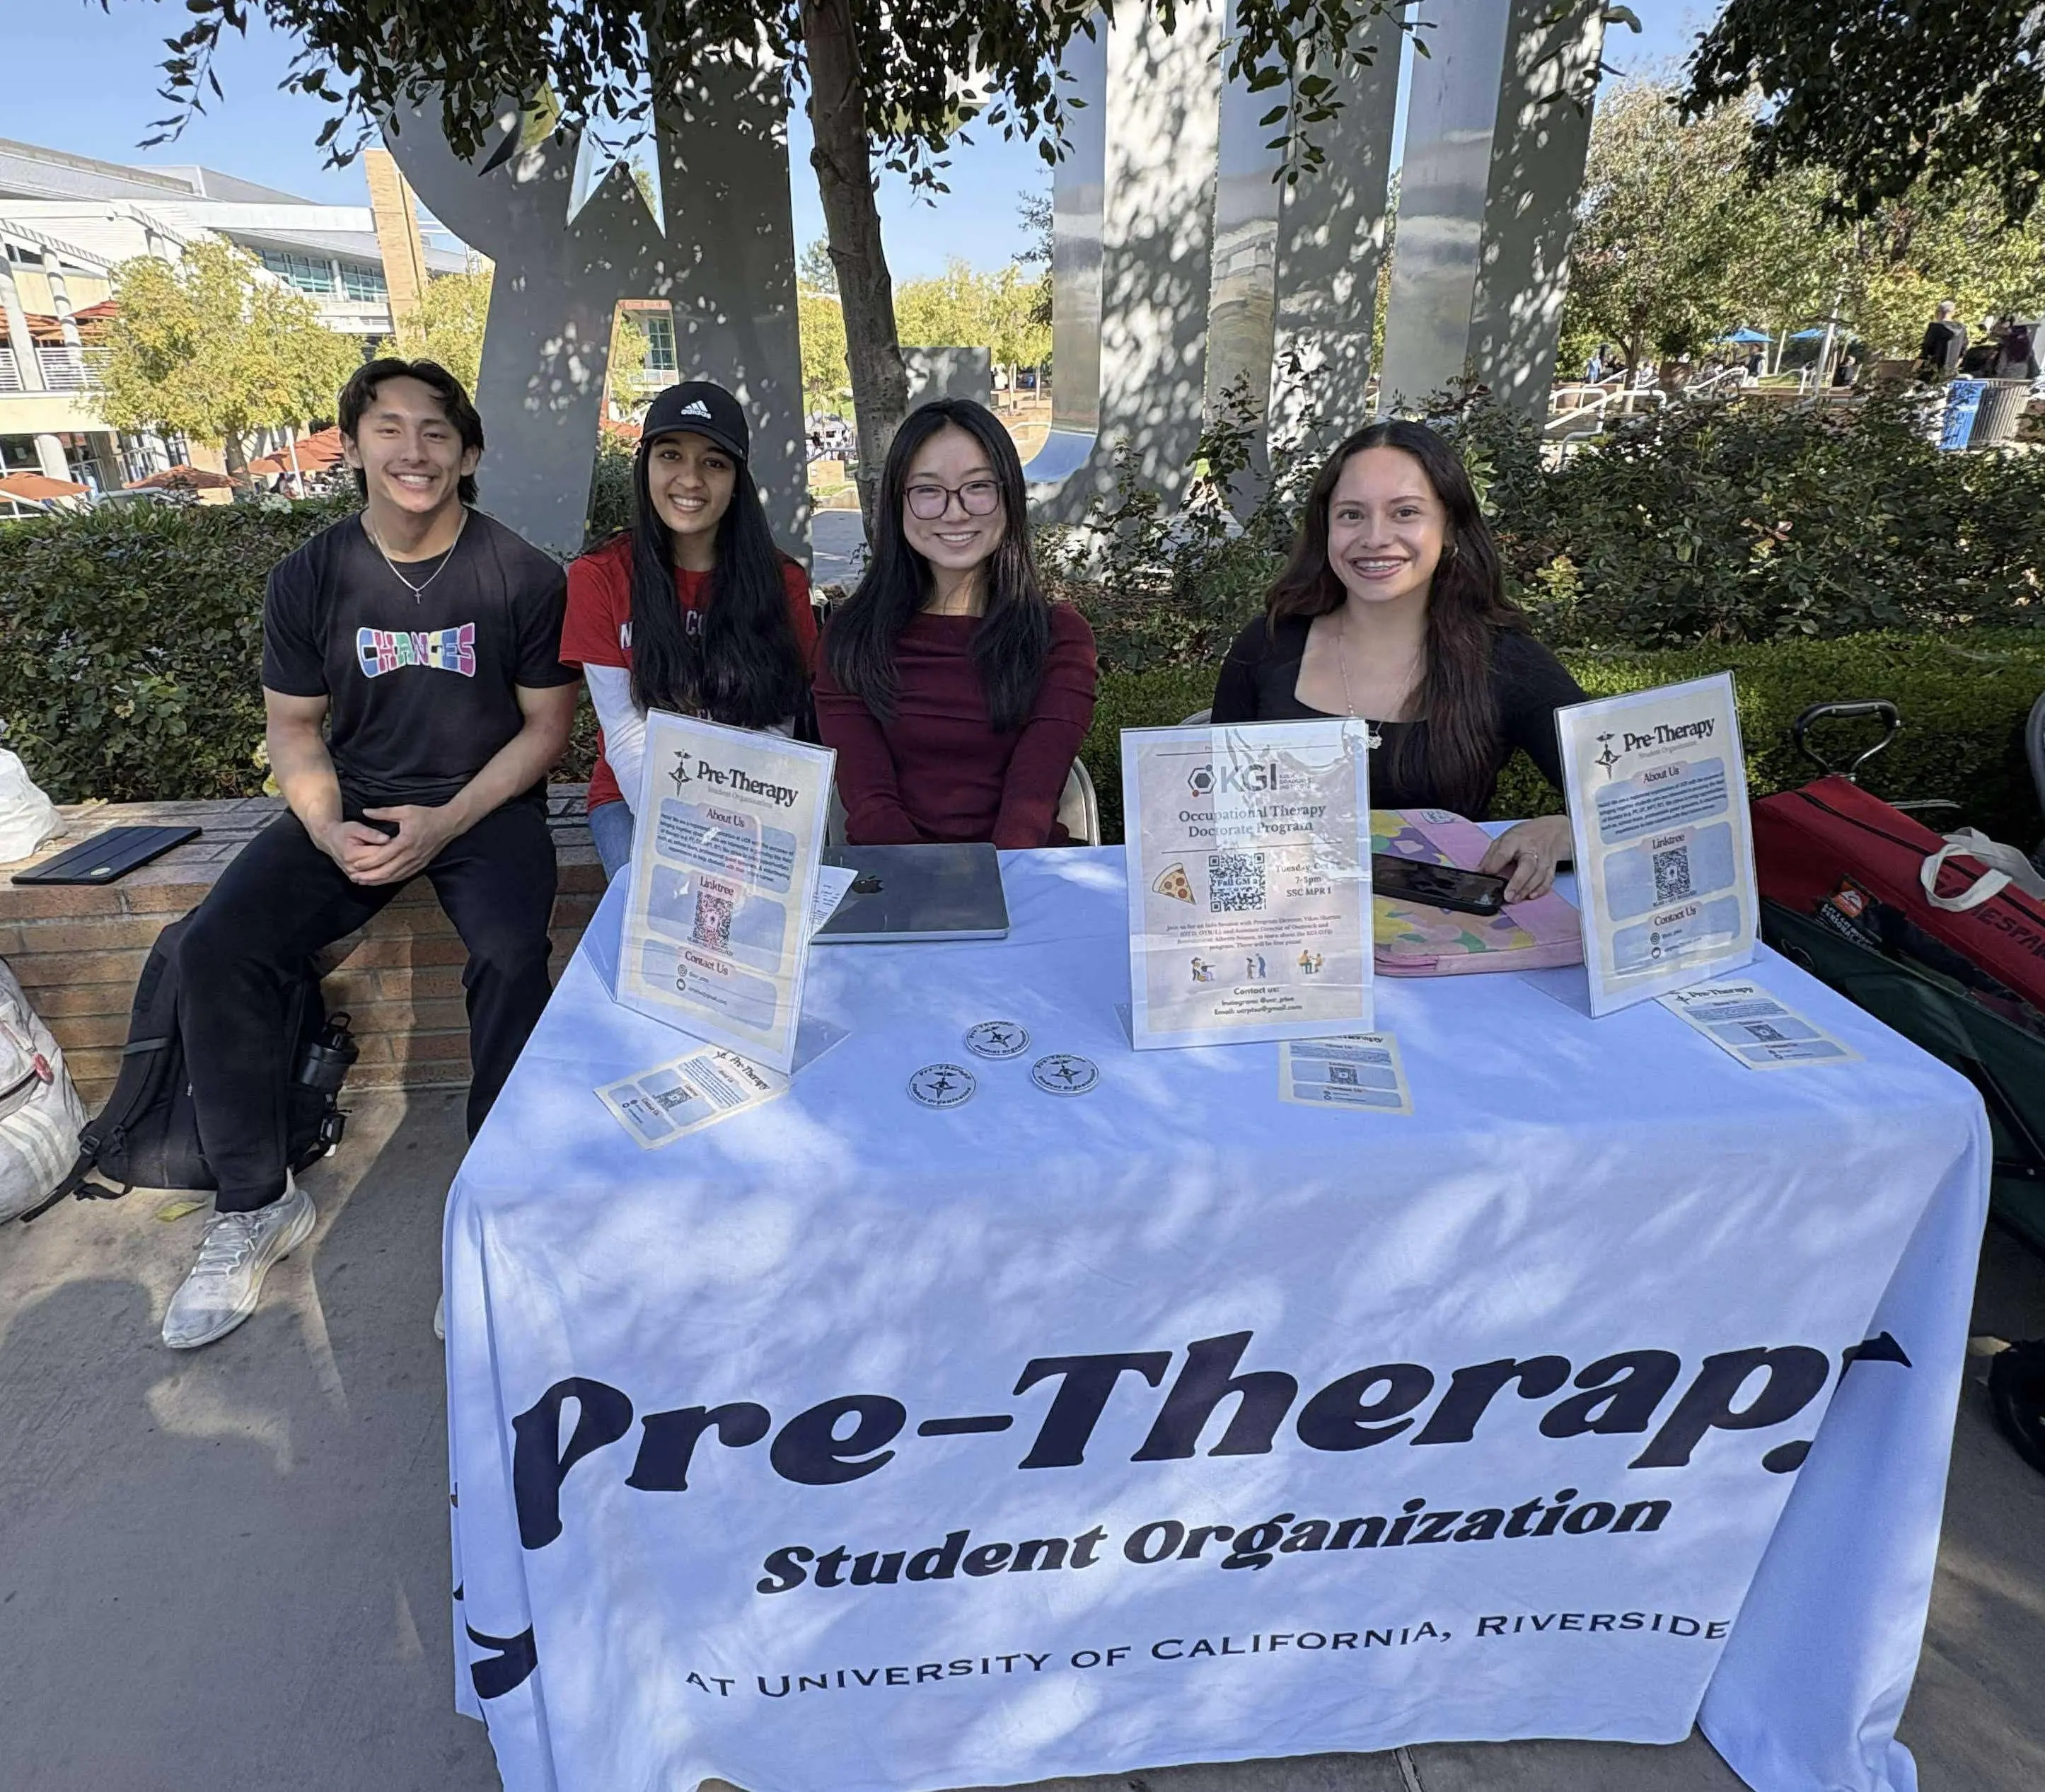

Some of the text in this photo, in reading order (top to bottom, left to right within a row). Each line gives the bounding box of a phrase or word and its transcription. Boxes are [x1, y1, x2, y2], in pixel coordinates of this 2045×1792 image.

[356, 622, 476, 678] CHANGES
[1623, 718, 1715, 751] Pre-Therapy
[697, 761, 799, 807] Pre-Therapy
[1221, 763, 1277, 793] KGI
[1643, 765, 1680, 784] About Us
[707, 808, 745, 828] About Us
[1178, 804, 1327, 822] Occupational Therapy
[1188, 821, 1314, 838] Doctorate Program
[1652, 833, 1685, 849] Linktree
[700, 876, 734, 896] Linktree
[1217, 878, 1234, 886] Fall
[1285, 889, 1304, 898] SSC
[1306, 887, 1326, 896] MPR
[1654, 906, 1697, 926] Contact Us
[685, 950, 729, 975] Contact Us
[729, 1056, 770, 1090] Pre-Therapy
[756, 1488, 1672, 1594] Student Organization
[685, 1612, 1731, 1698] AT UNIVERSITY OF CALIFORNIA, RIVERSIDE
